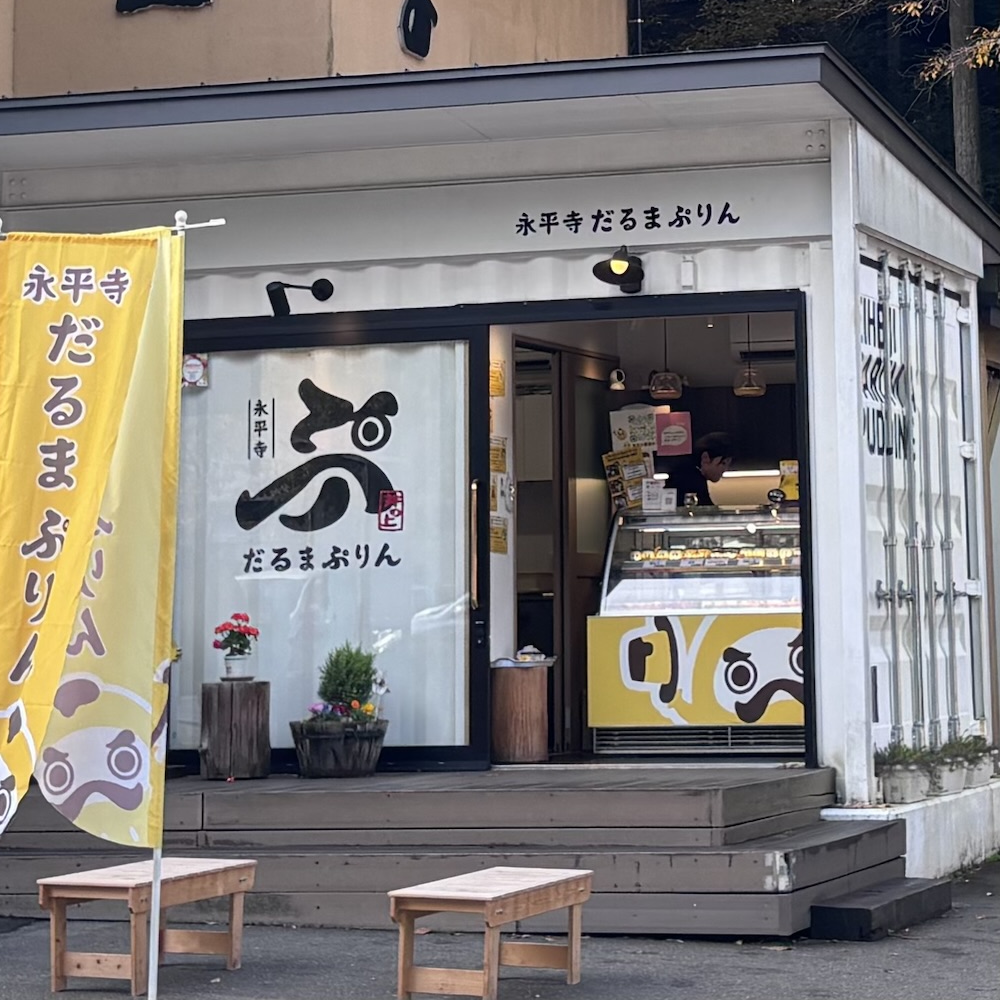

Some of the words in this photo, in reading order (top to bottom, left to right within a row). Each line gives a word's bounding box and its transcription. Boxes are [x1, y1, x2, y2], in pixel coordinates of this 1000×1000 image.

[516, 202, 740, 236] 永平寺だるまぷりん
[23, 264, 131, 306] 永平寺
[253, 399, 270, 459] 永平寺
[243, 543, 402, 574] だるまぷりん
